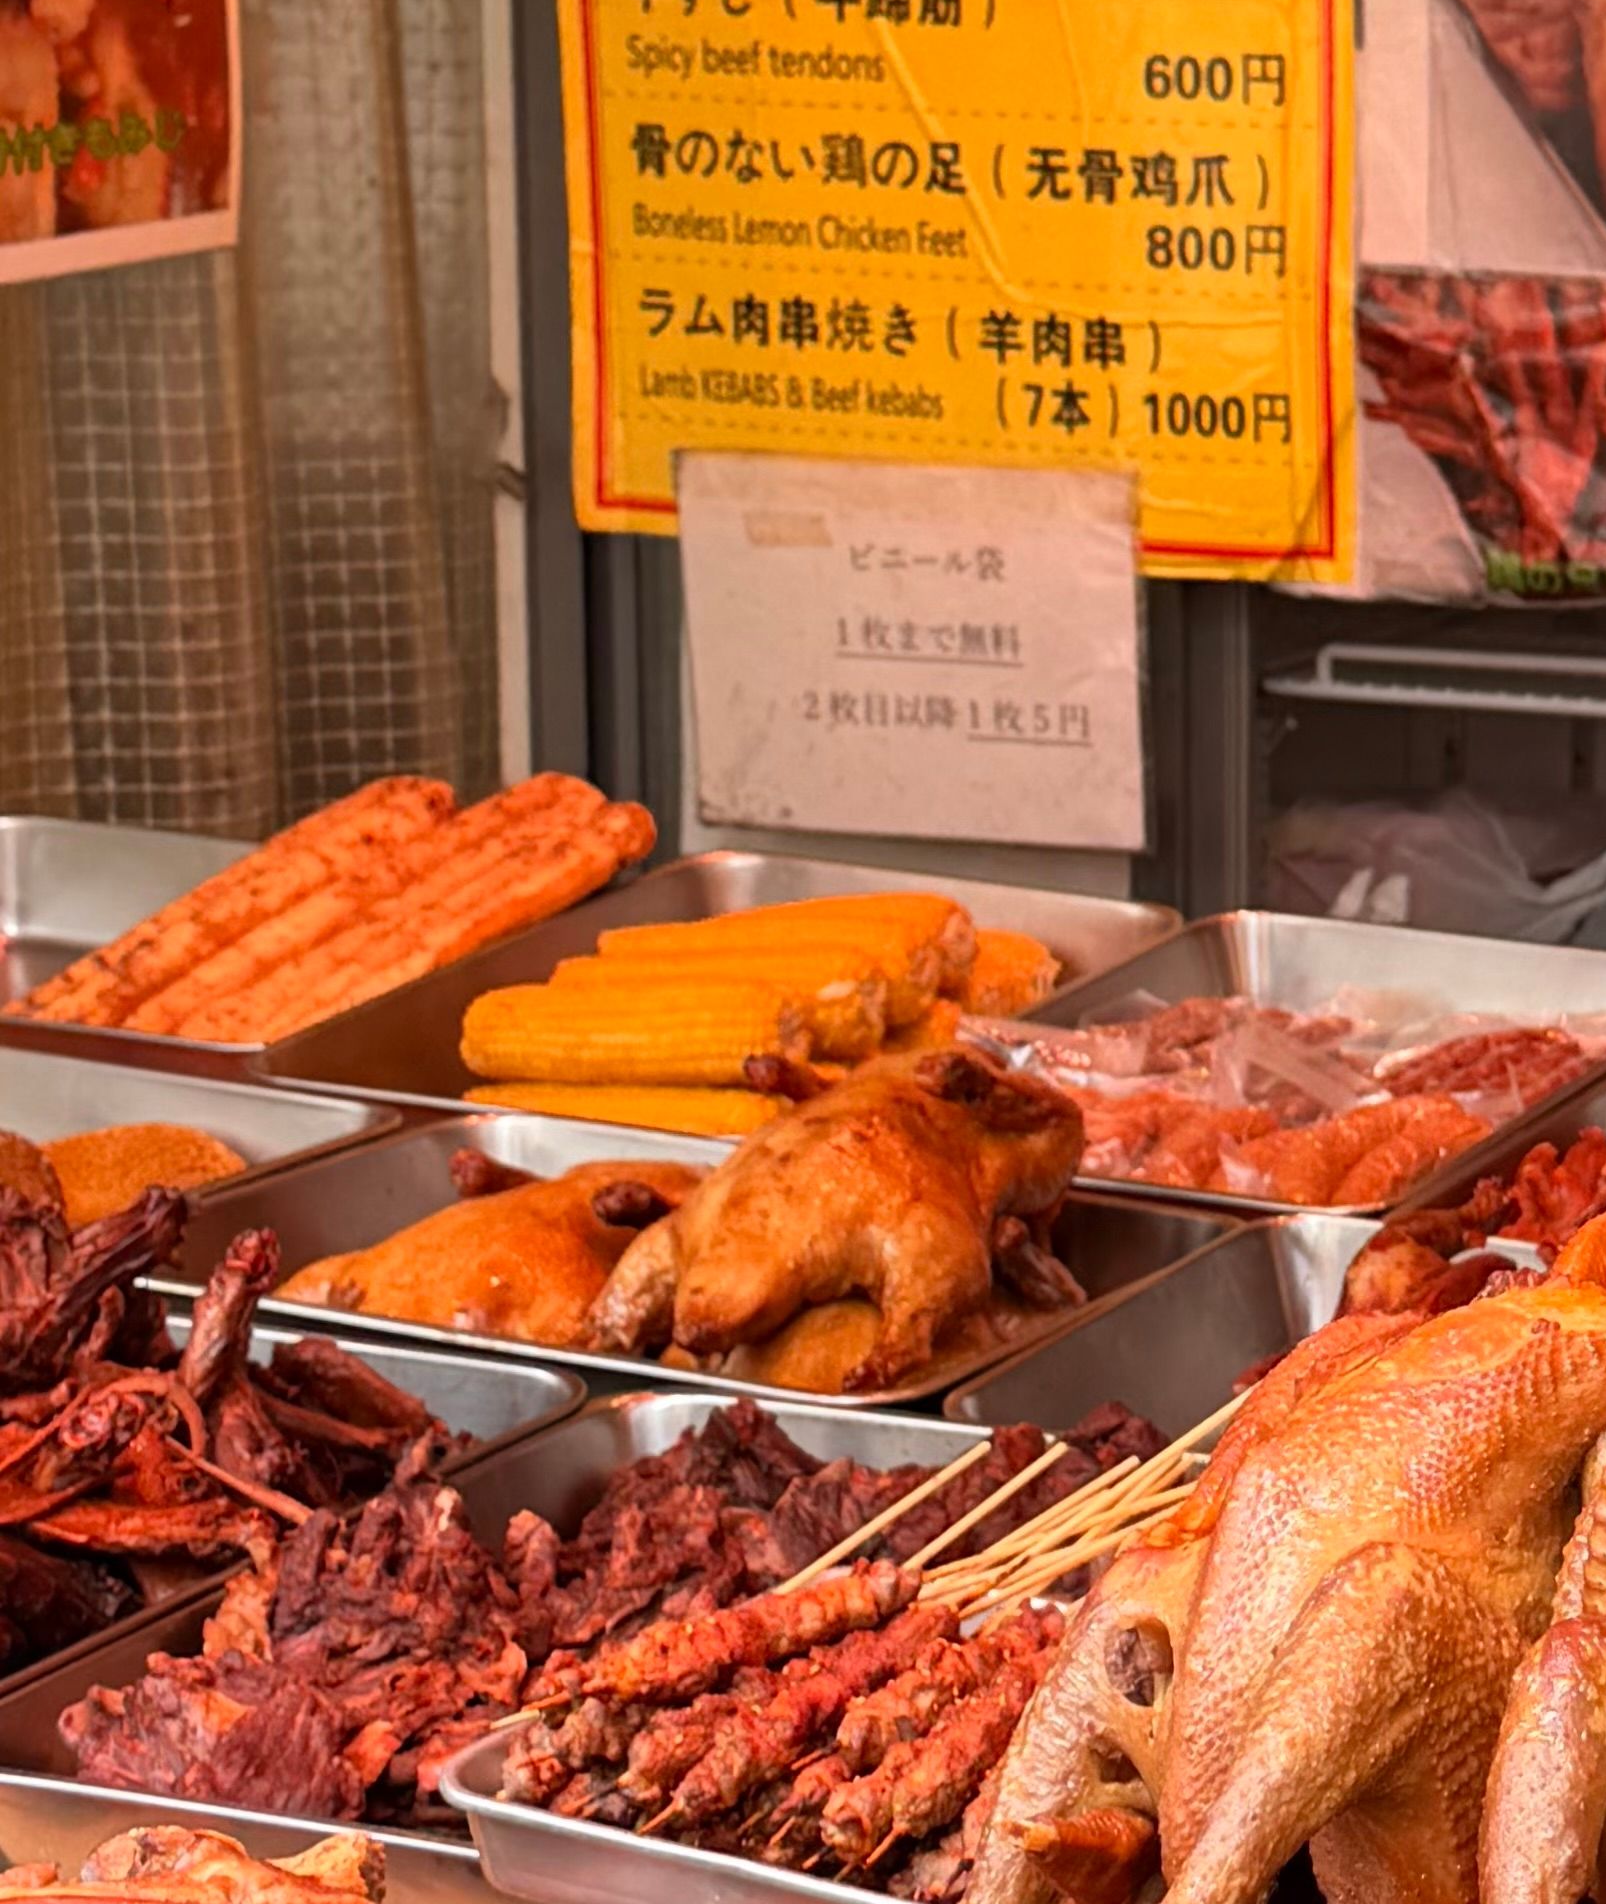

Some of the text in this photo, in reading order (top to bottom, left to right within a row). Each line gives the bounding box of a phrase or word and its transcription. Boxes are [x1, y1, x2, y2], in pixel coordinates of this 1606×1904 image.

[626, 34, 885, 82] Spicy beef tendons
[1143, 54, 1285, 107] 600円
[632, 202, 967, 257] Boneless Lemon Chicken Feet
[1146, 225, 1286, 278] 800円
[640, 366, 695, 400] Lamb
[701, 370, 779, 407] KEBABS
[811, 377, 859, 413] Beef
[865, 382, 943, 420] kebabs
[1143, 388, 1292, 445] 1000円
[849, 545, 1005, 581] ビニール袋
